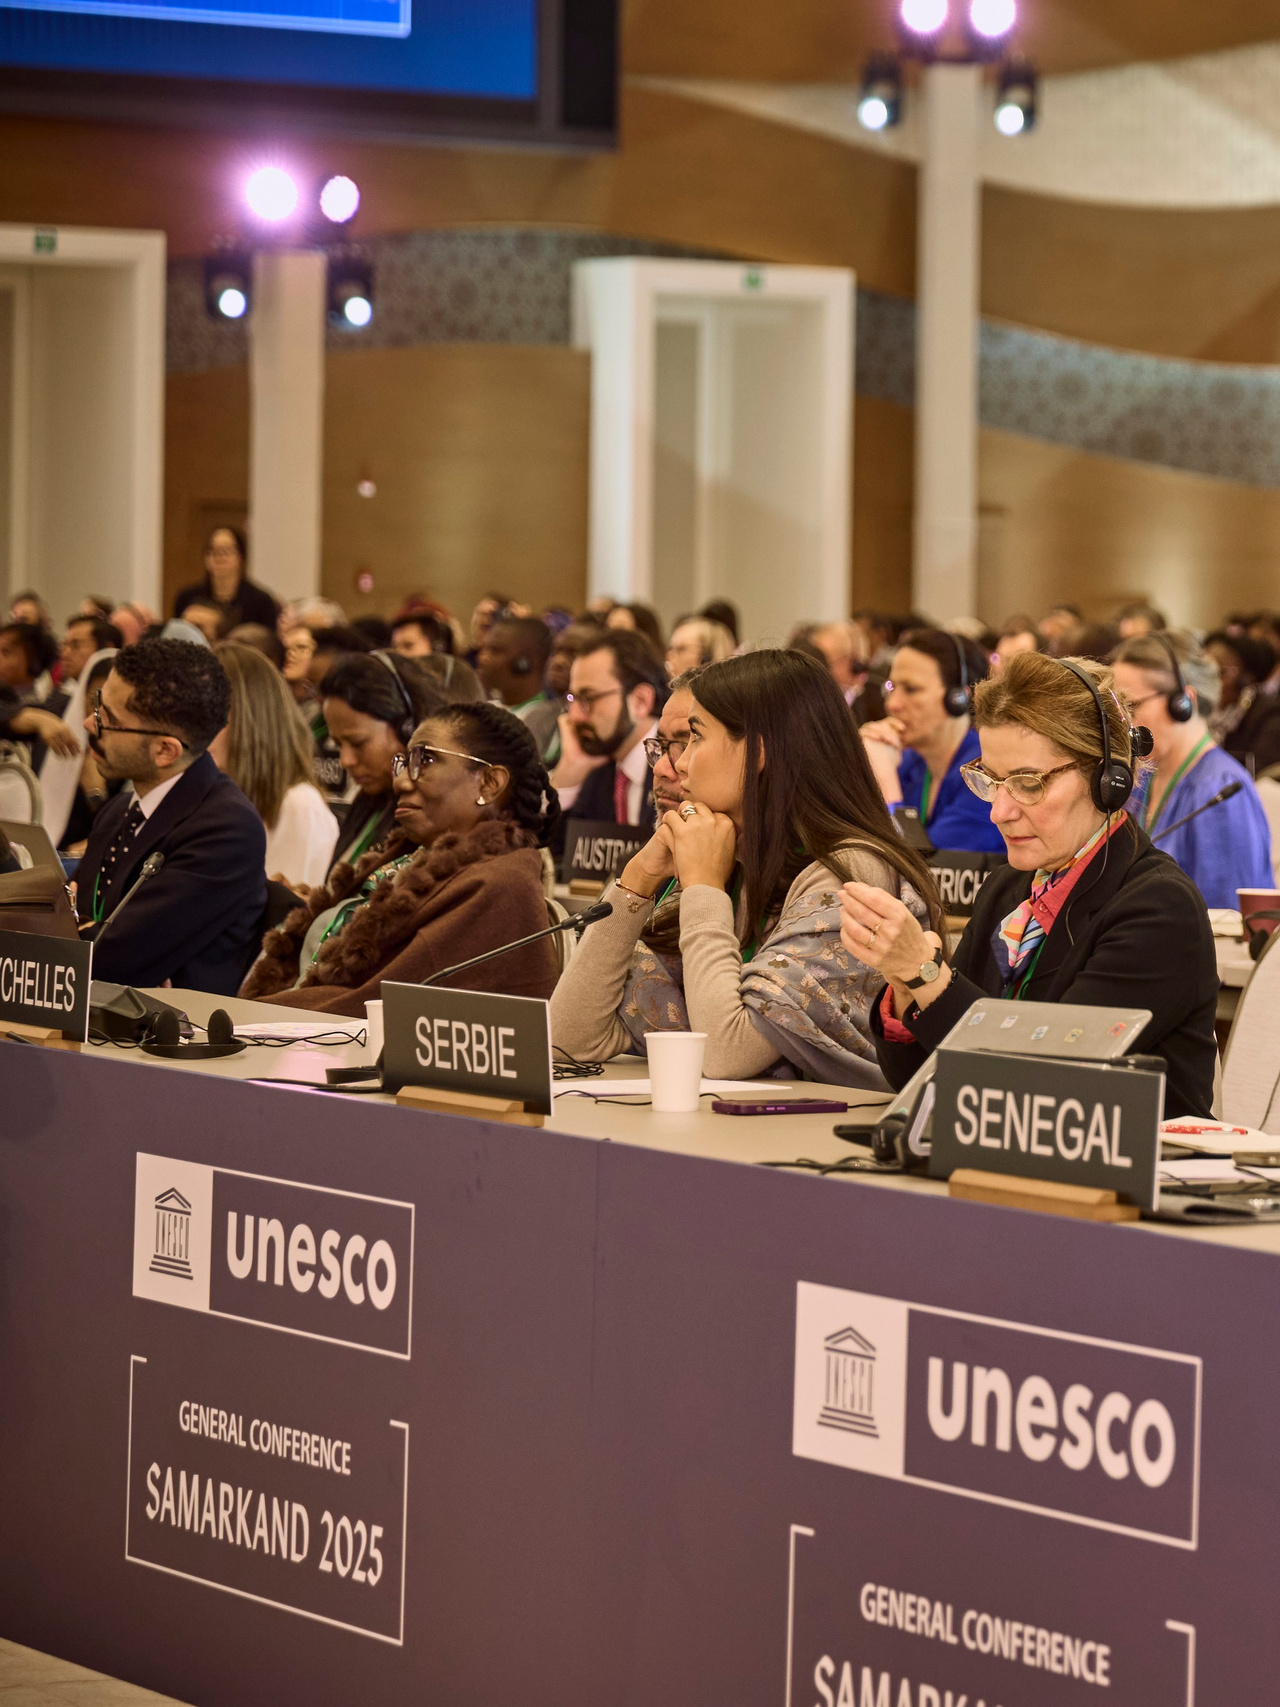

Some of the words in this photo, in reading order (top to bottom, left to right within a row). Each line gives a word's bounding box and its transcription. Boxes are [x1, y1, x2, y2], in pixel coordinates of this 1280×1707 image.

[0, 957, 76, 1012] CHELLES
[415, 1015, 518, 1079] SERBIE
[954, 1084, 1133, 1168] SENEGAL
[227, 1211, 397, 1311] unesco
[179, 1400, 247, 1447] GENERAL
[250, 1419, 351, 1475] CONFERENCE
[927, 1356, 1176, 1488] unesco
[146, 1462, 310, 1563] SAMARKAND
[319, 1510, 384, 1587] 2025
[860, 1582, 958, 1645] GENERAL
[962, 1610, 1111, 1687] CONFERENCE
